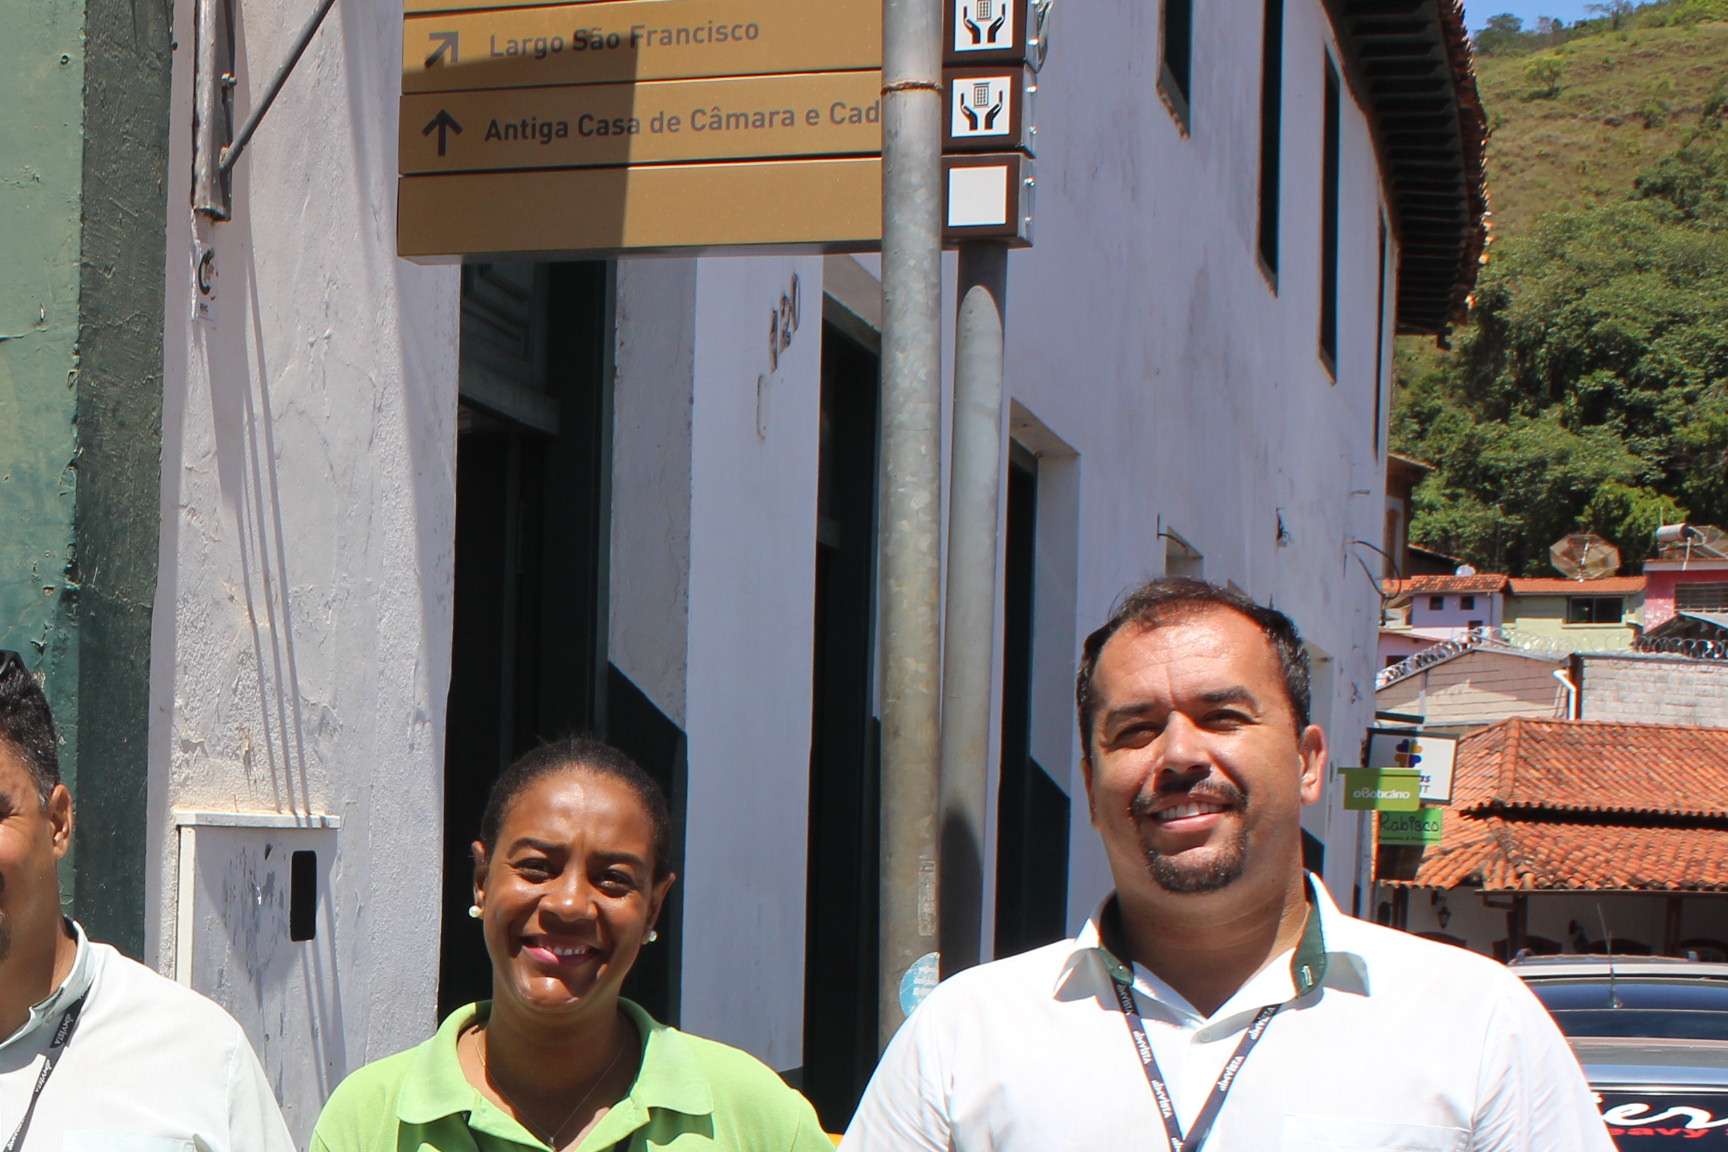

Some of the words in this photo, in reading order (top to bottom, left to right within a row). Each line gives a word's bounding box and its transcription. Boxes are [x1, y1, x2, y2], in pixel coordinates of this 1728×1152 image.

[489, 35, 564, 60] Largo
[573, 27, 620, 52] São
[630, 20, 760, 49] Francisco
[483, 116, 569, 146] Antiga
[577, 113, 640, 138] Casa
[649, 111, 682, 134] de
[689, 106, 796, 132] Câmara
[804, 110, 820, 126] e
[1380, 812, 1440, 832] Rabisco
